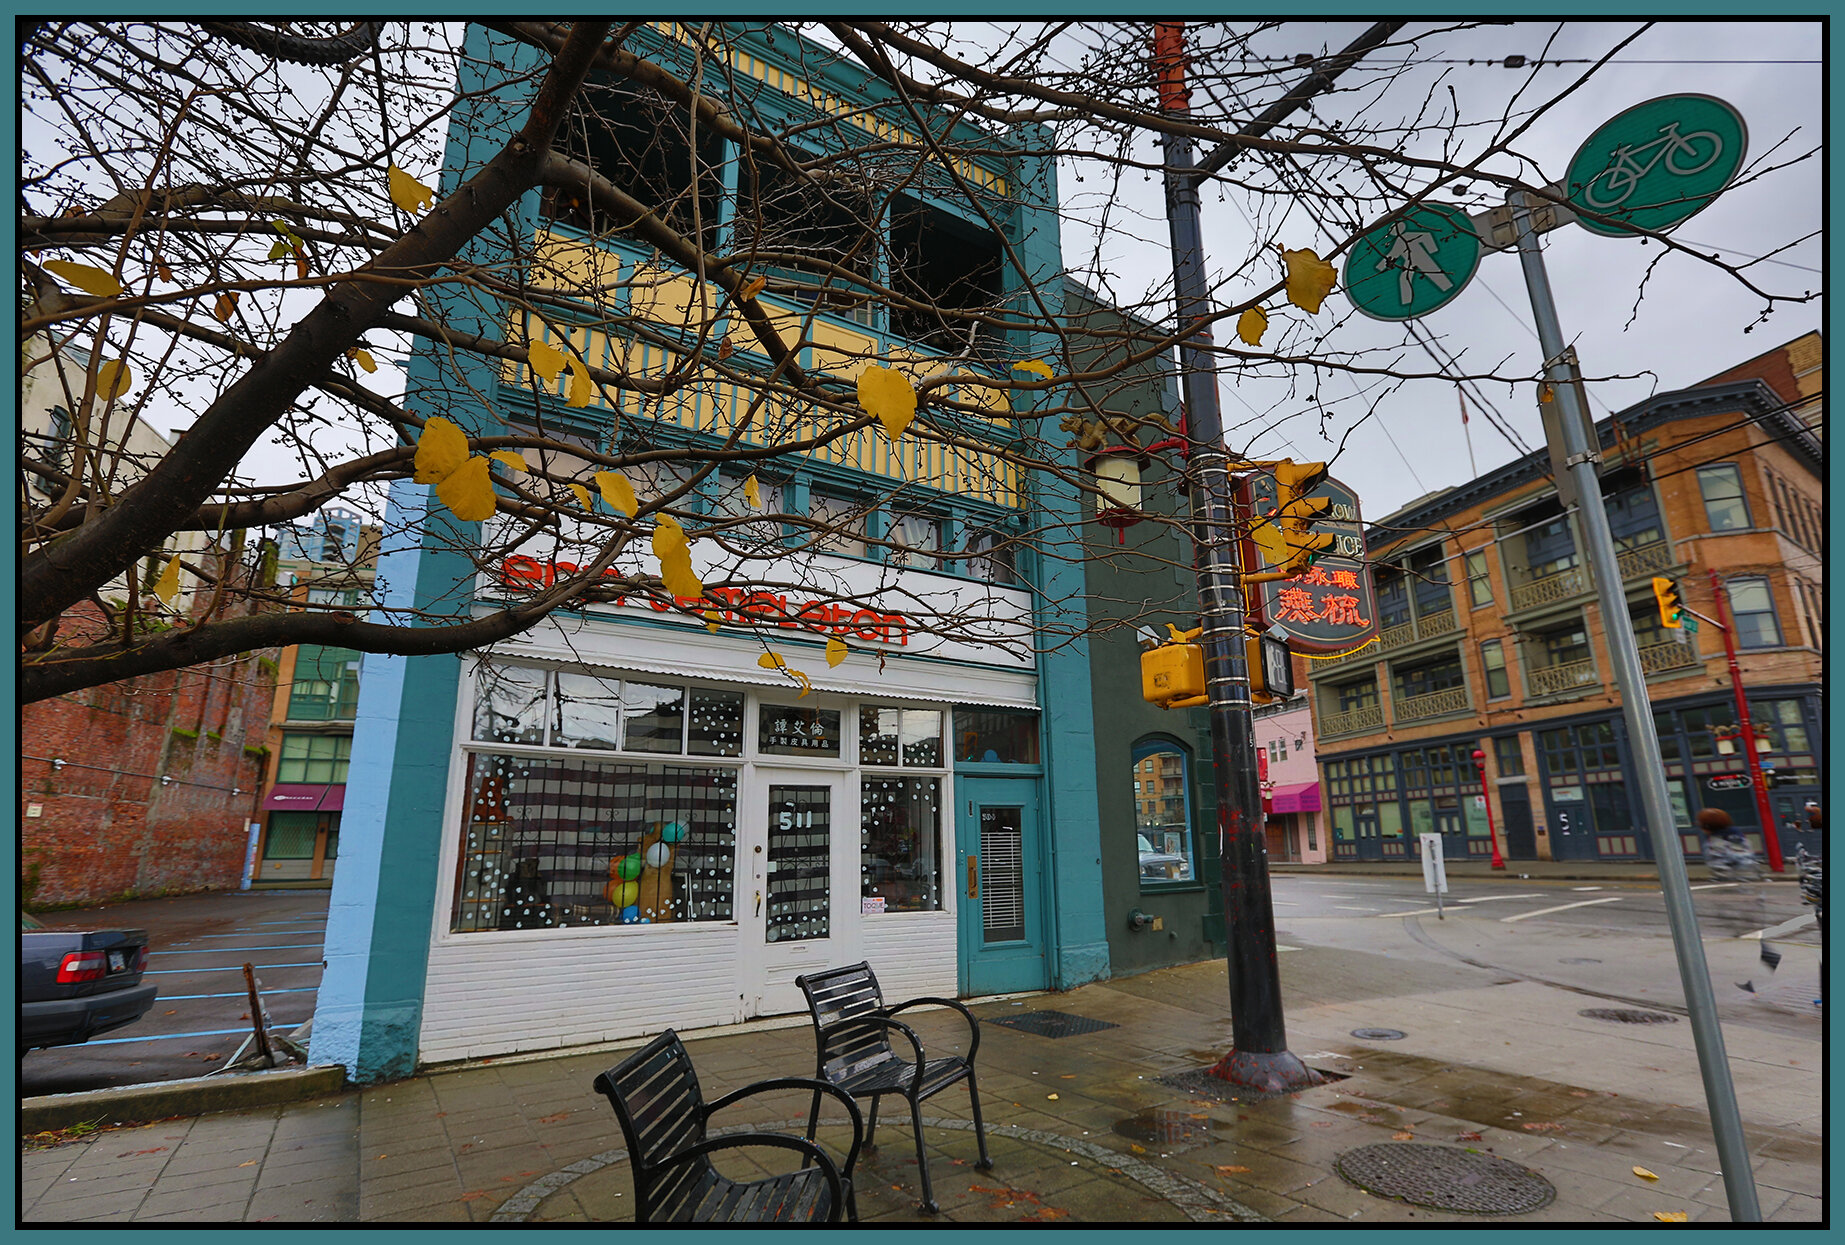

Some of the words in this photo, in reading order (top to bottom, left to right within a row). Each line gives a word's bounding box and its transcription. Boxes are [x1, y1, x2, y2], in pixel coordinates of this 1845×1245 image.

[769, 736, 829, 748] 手製皮具用品
[780, 810, 812, 830] 511
